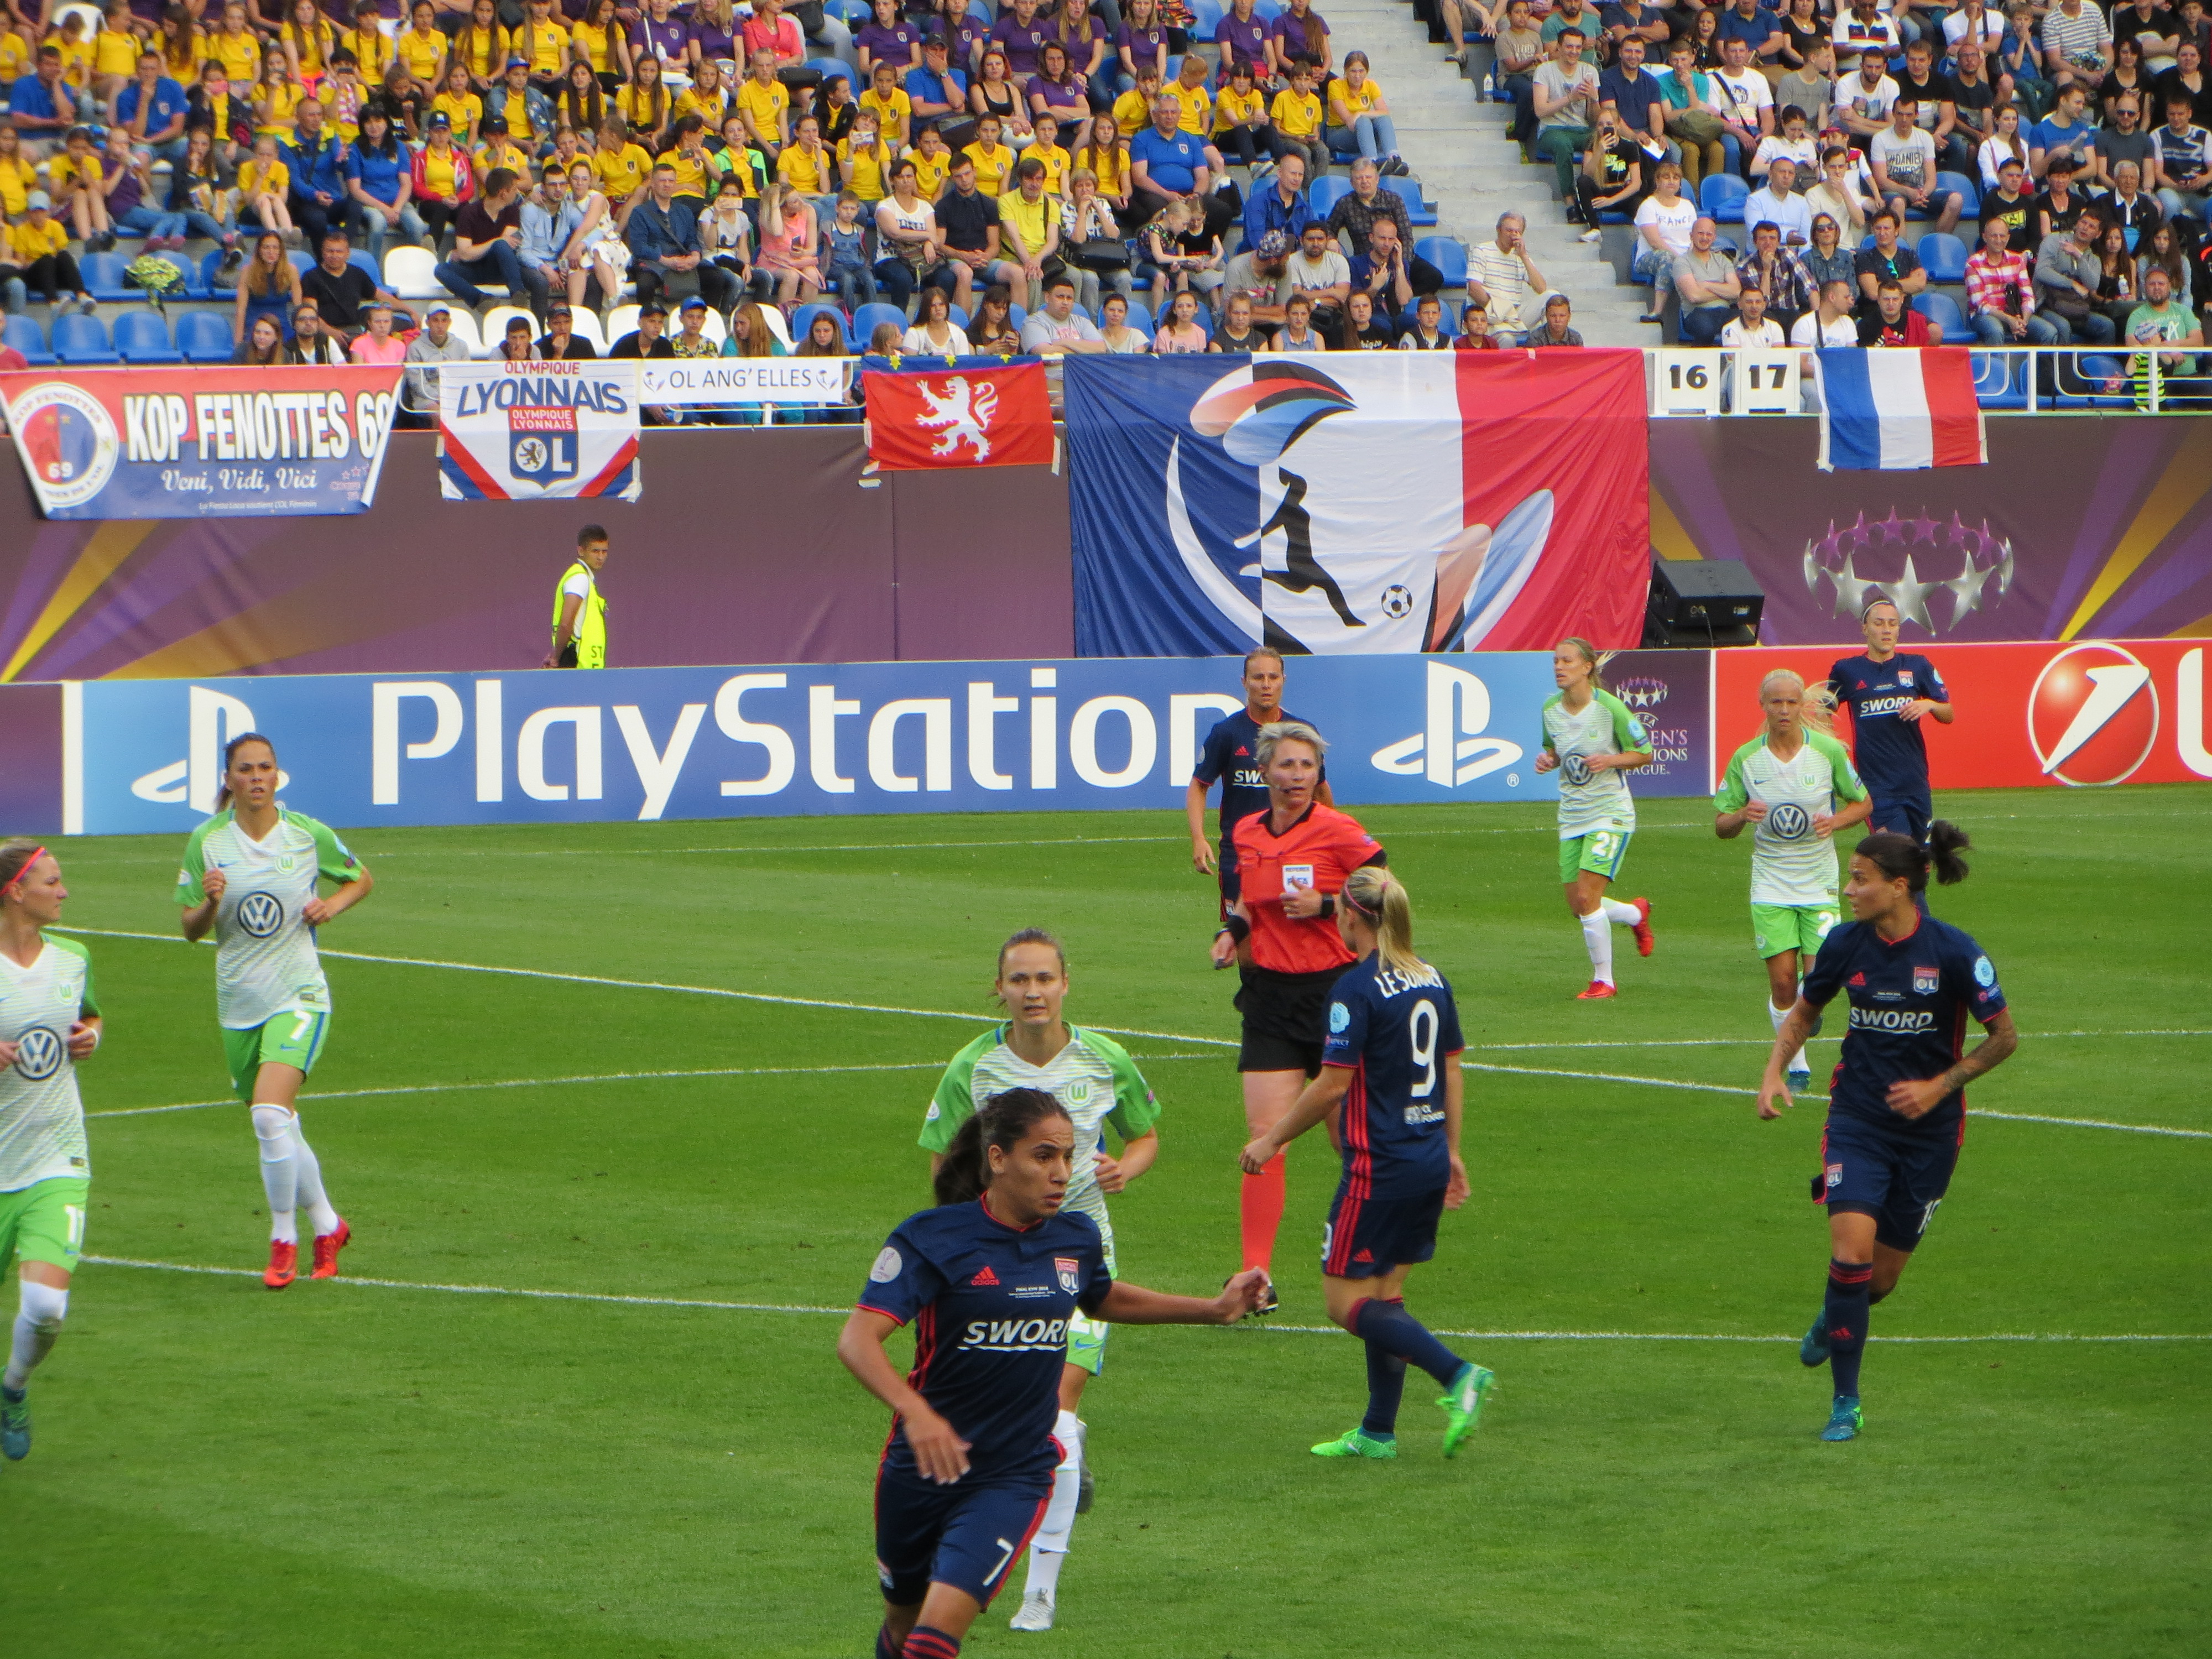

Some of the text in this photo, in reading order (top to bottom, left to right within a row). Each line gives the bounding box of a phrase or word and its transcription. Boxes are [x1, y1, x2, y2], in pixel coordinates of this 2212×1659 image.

[505, 361, 580, 375] OLYMPIQUE
[670, 369, 696, 388] OL
[1669, 364, 1708, 389] 16
[1749, 364, 1788, 389] 17
[457, 377, 628, 418] LYONNAIS
[123, 393, 188, 462] KOP
[194, 391, 349, 461] FENOTTES
[512, 409, 571, 420] OLYMPIQUE
[513, 420, 574, 430] LYONNAIS
[48, 460, 74, 479] 69
[161, 469, 214, 494] Veni,
[219, 467, 270, 493] Vidi,
[276, 467, 317, 489] Vici
[373, 668, 1245, 821] PlayStation
[1651, 729, 1688, 746] EN'S
[1592, 831, 1620, 859] 21
[1817, 910, 1841, 938] 2
[290, 1010, 313, 1041] 7
[1851, 1006, 1933, 1031] SWORD
[1410, 1000, 1439, 1097] 9
[983, 1537, 1015, 1587] 7
